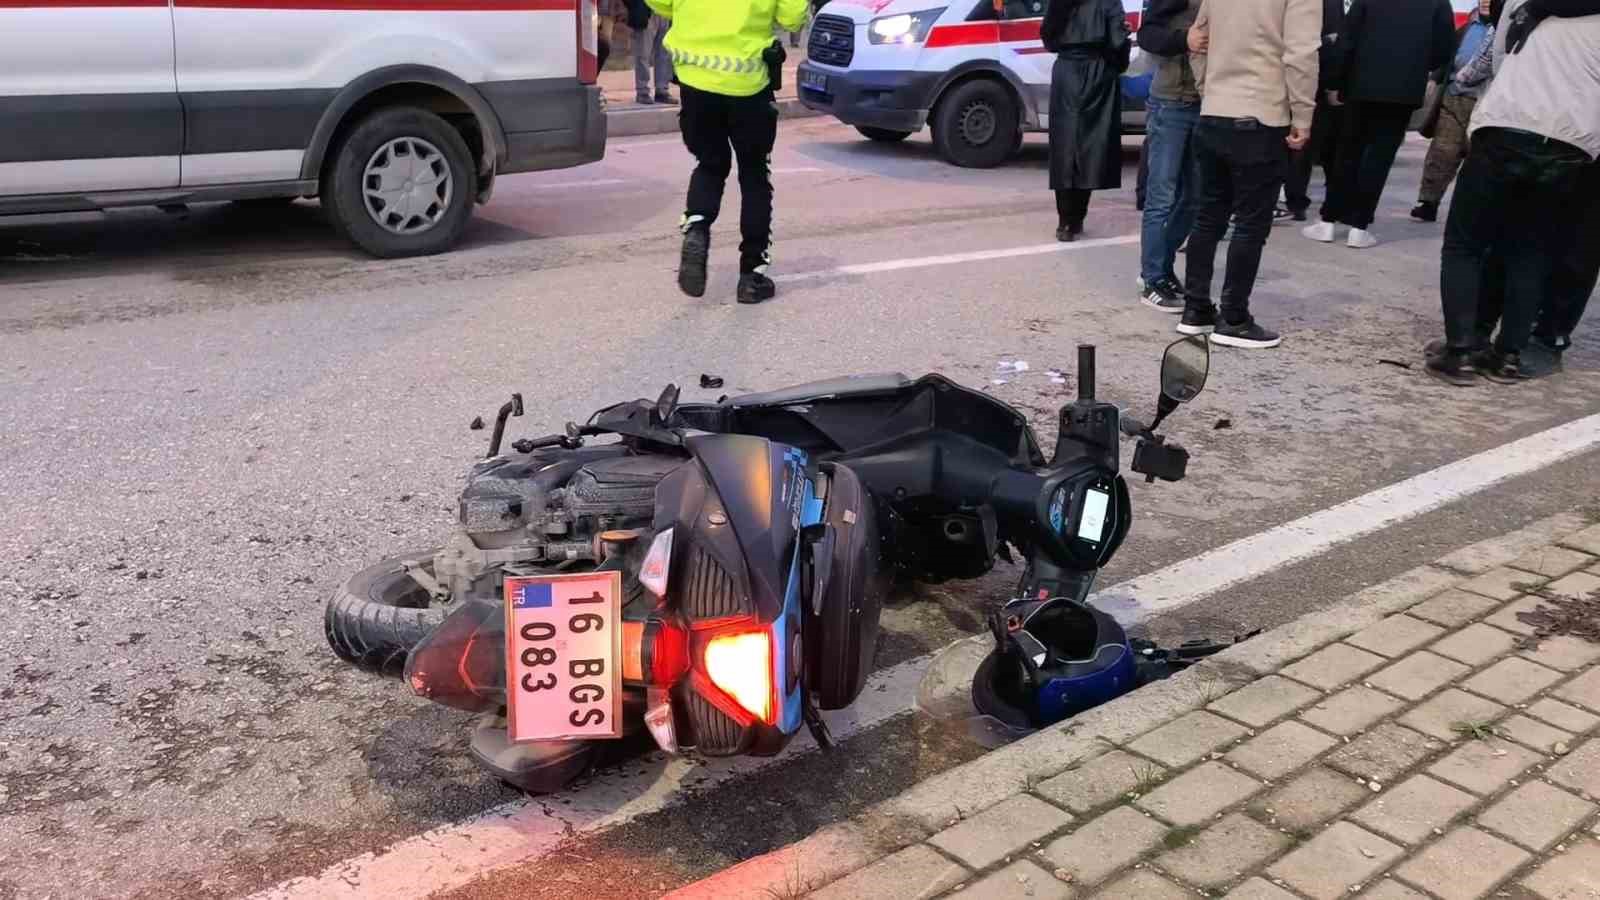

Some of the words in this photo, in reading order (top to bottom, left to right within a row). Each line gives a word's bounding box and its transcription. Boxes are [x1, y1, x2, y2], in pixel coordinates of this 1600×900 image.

[512, 587, 526, 605] TR
[568, 591, 605, 634] 16
[520, 622, 558, 693] 083
[568, 658, 605, 727] BGS
